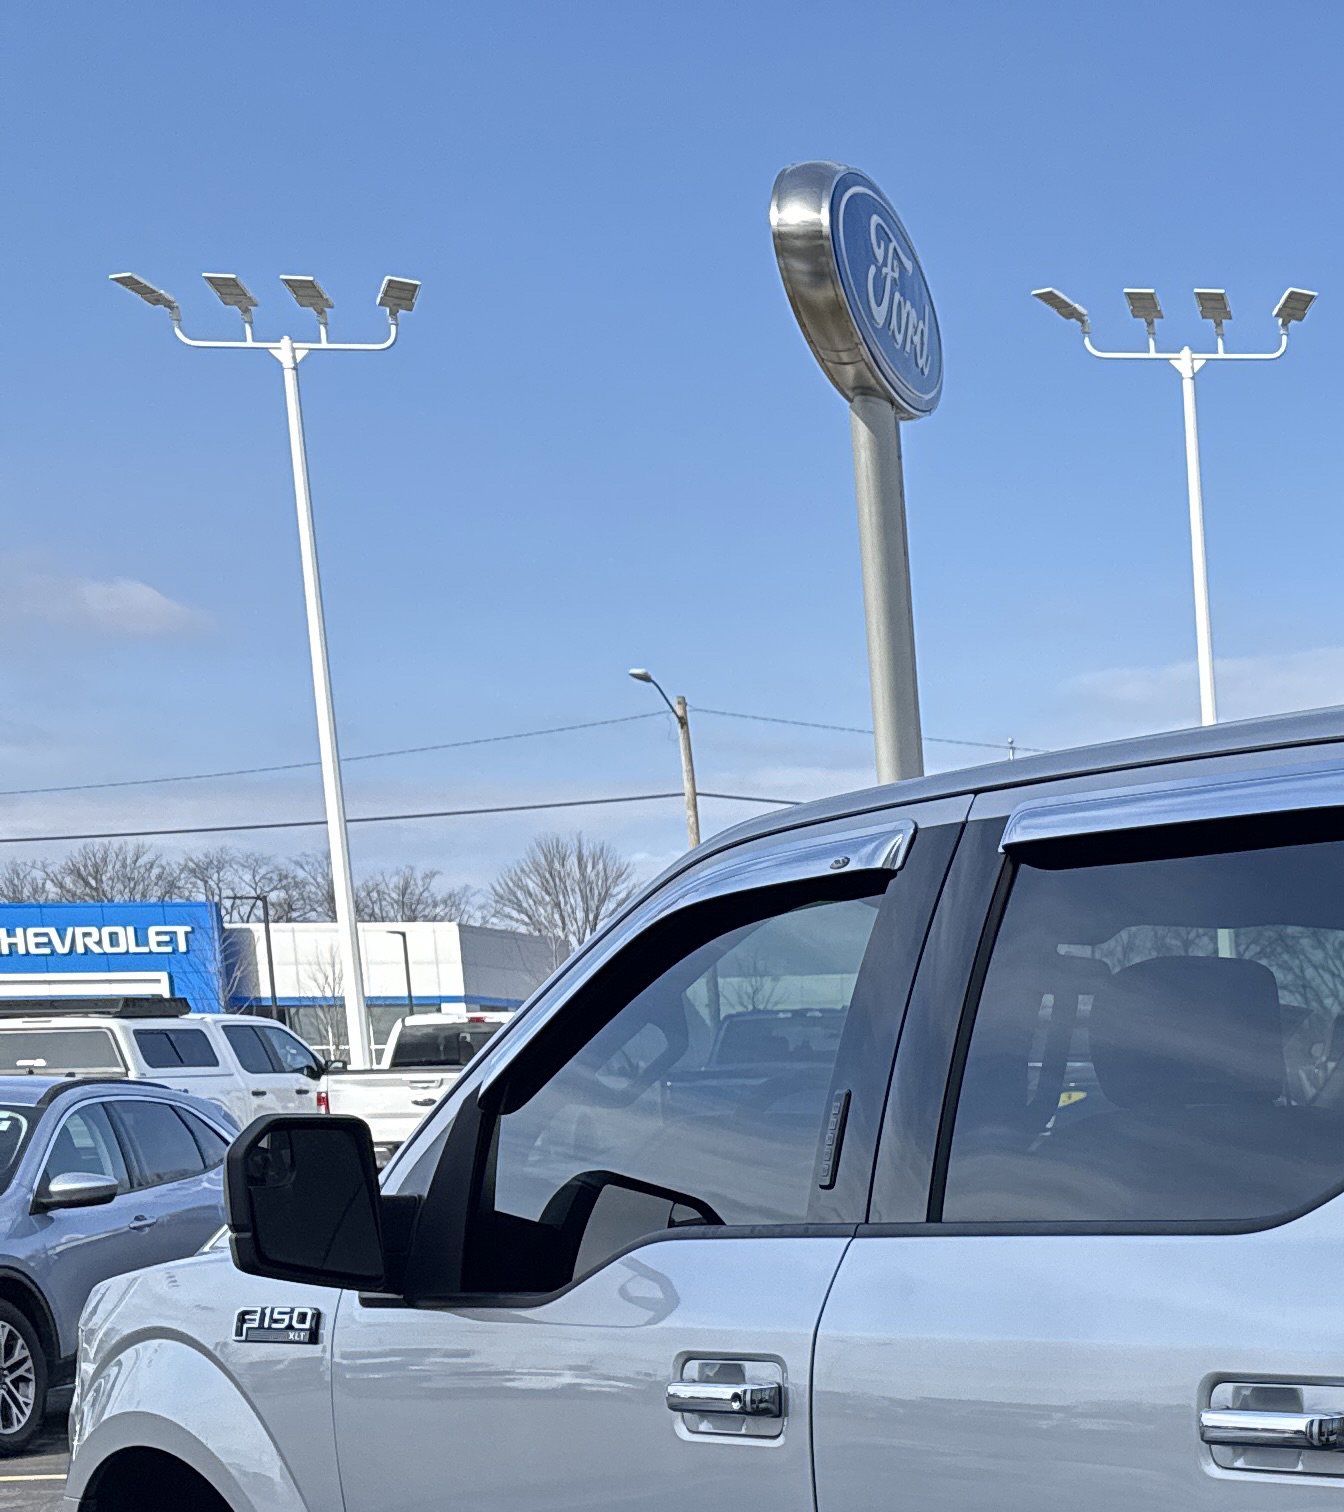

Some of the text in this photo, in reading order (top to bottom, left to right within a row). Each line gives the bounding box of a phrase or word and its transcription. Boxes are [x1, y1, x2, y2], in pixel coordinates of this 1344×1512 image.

[868, 214, 932, 377] Ford
[232, 1306, 313, 1340] F150
[288, 1331, 306, 1341] XLT
